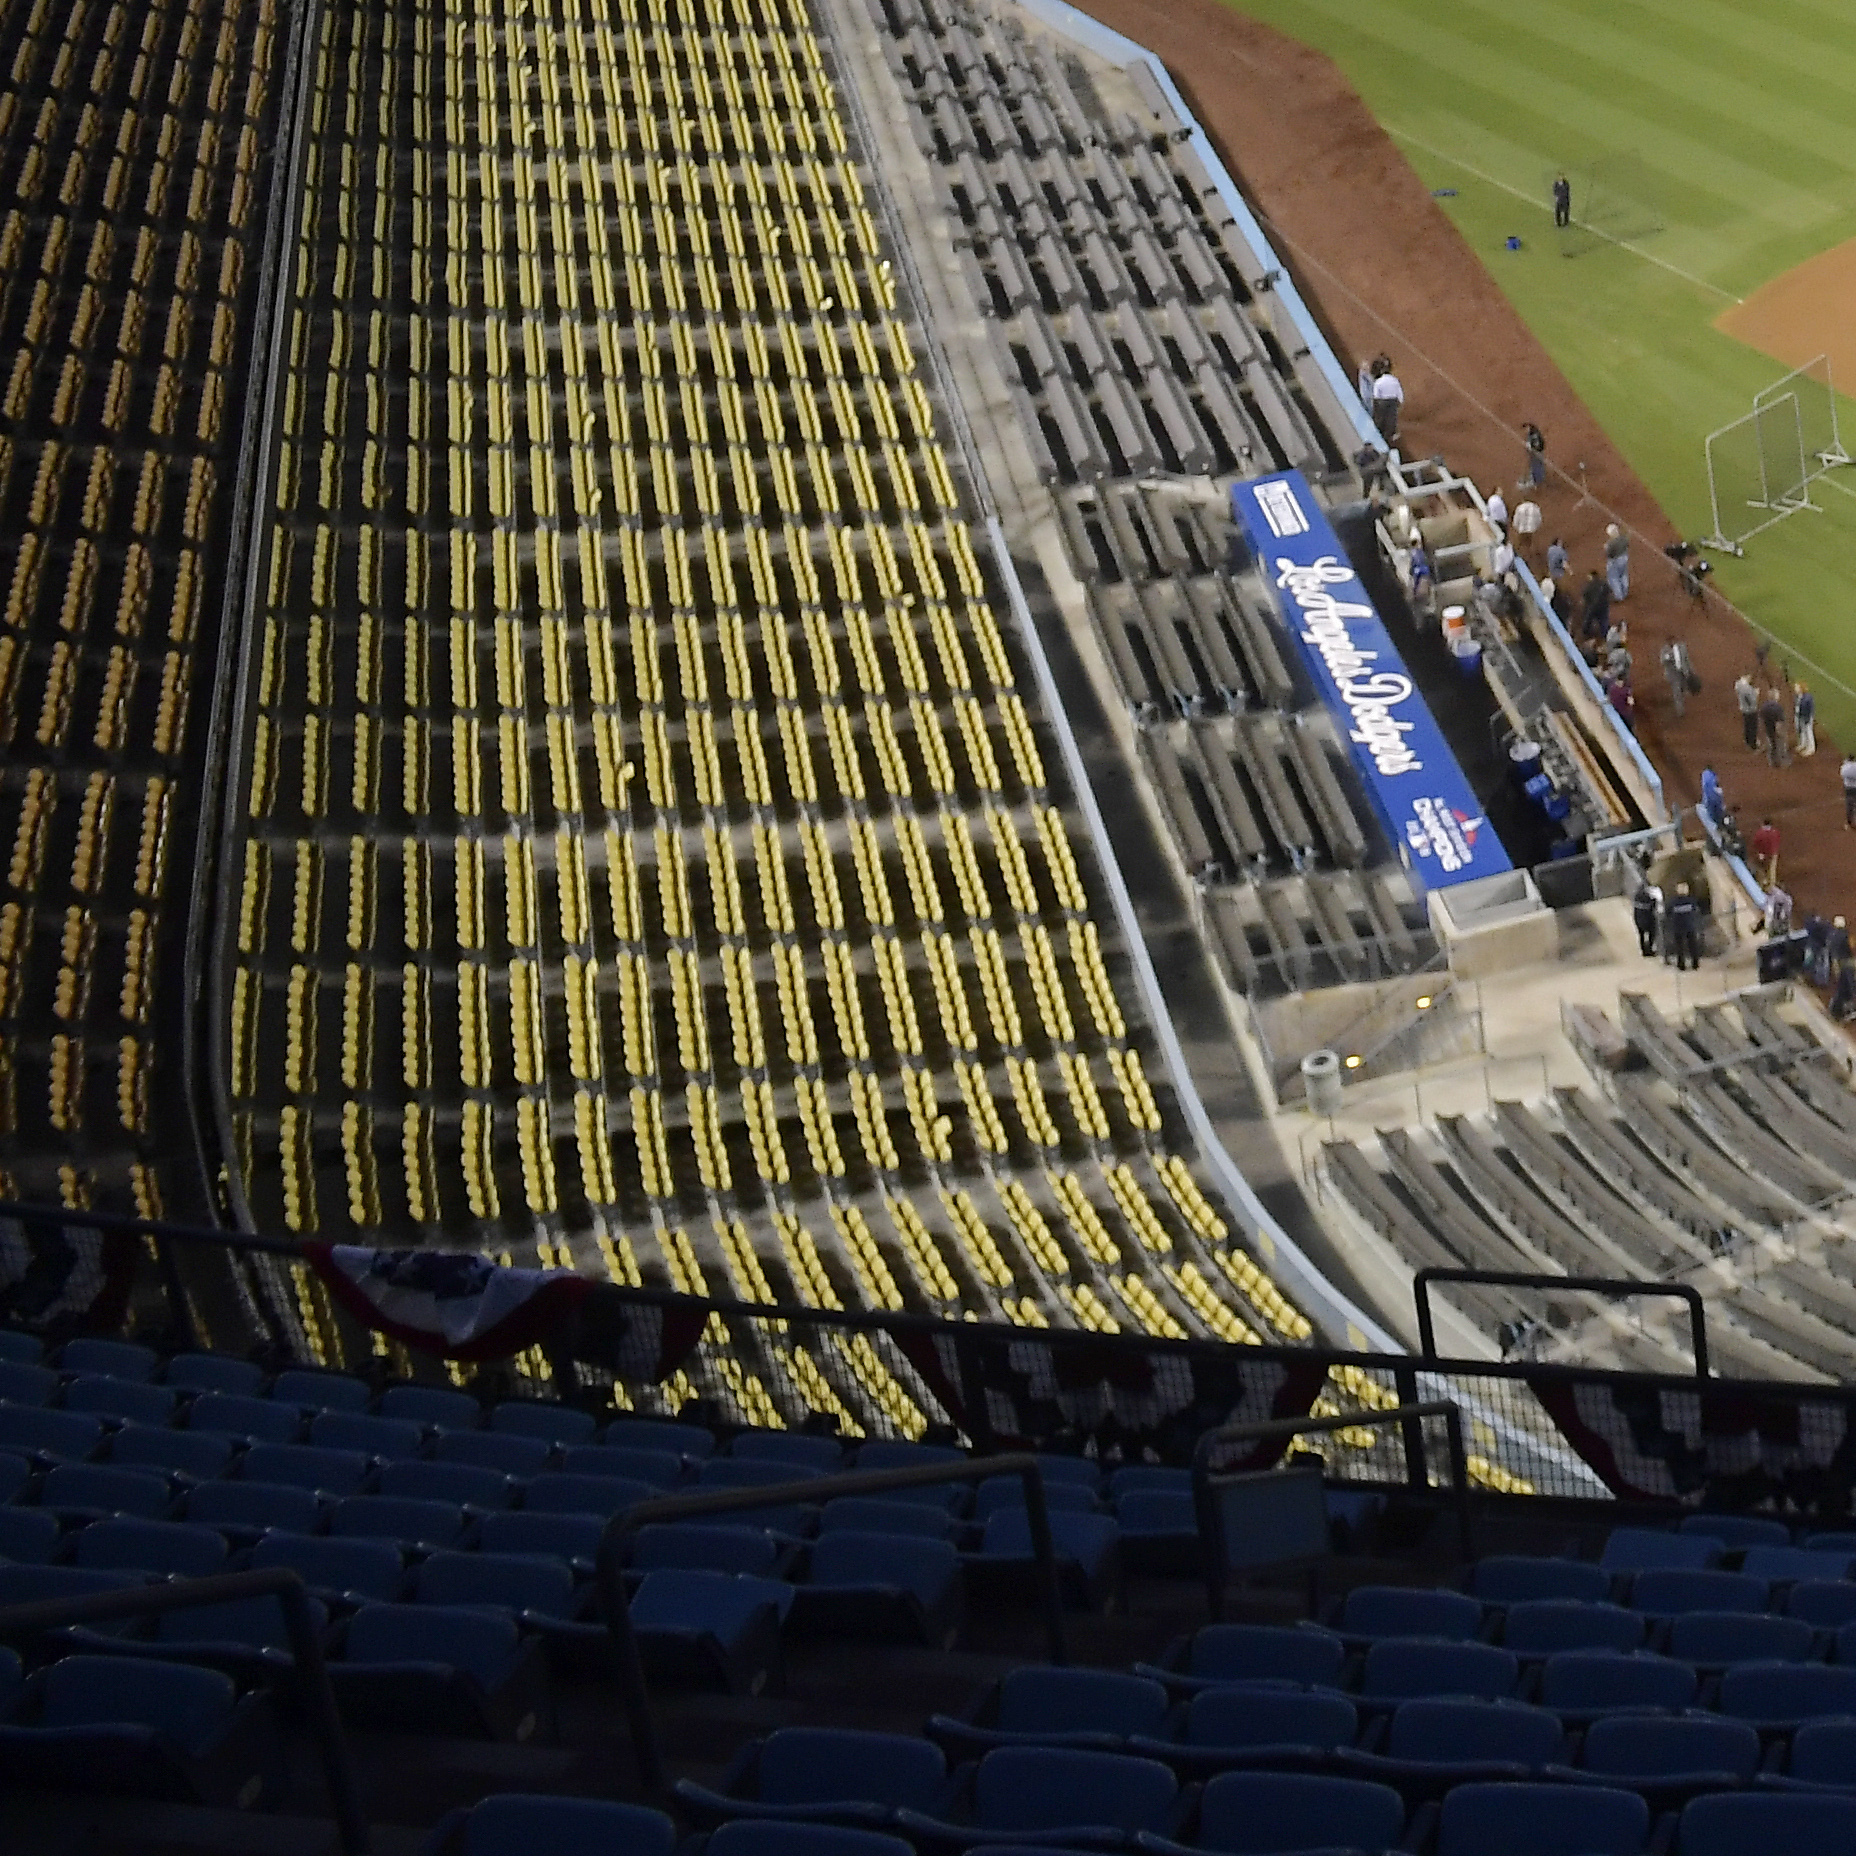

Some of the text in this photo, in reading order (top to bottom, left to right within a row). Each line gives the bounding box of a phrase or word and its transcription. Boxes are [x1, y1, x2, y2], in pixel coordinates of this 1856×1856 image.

[1276, 556, 1355, 594] Los
[1296, 592, 1378, 691] Angeles
[1342, 672, 1424, 776] Dodgers
